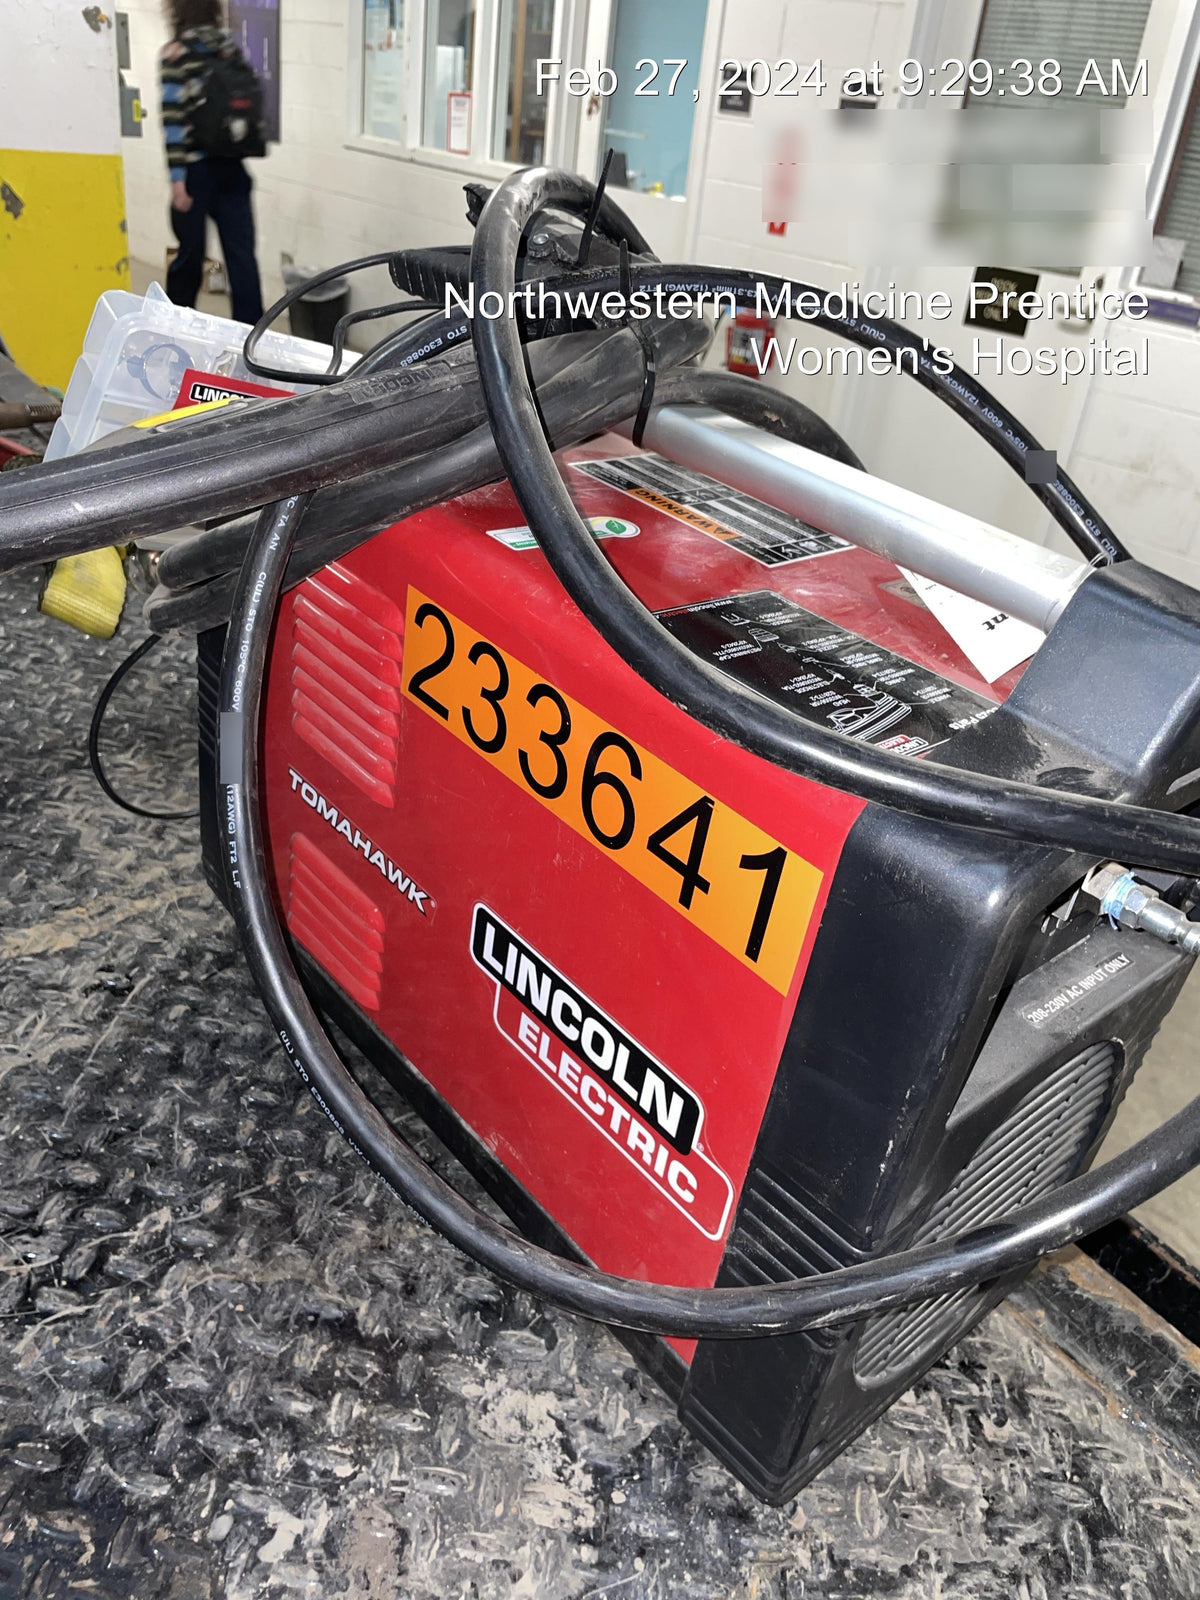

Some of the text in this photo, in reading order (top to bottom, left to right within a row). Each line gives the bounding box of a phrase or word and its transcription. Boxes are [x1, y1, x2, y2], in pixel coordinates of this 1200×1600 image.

[665, 284, 709, 293] (12AWG)
[447, 325, 468, 340] STO
[920, 356, 931, 370] TA
[980, 407, 1003, 429] 600V
[635, 488, 715, 530] WARNING
[278, 515, 290, 528] TA
[1085, 518, 1101, 537] STO
[269, 533, 281, 551] AN
[245, 609, 257, 632] STO
[232, 680, 243, 712] 600V
[948, 715, 979, 730] Parts
[408, 602, 788, 964] 233641
[226, 784, 237, 834] (12AWG)
[289, 767, 429, 914] TOMAHAWK
[229, 841, 238, 864] FT2
[1027, 953, 1132, 1023] 208-230V AC INPUT ONLY
[483, 922, 685, 1138] LINCOLN
[280, 1030, 294, 1054] (UL)
[294, 1058, 309, 1083] STO
[311, 1086, 345, 1135] E300888
[348, 1138, 370, 1166] VW-1
[518, 1012, 698, 1203] ELECTRIC
